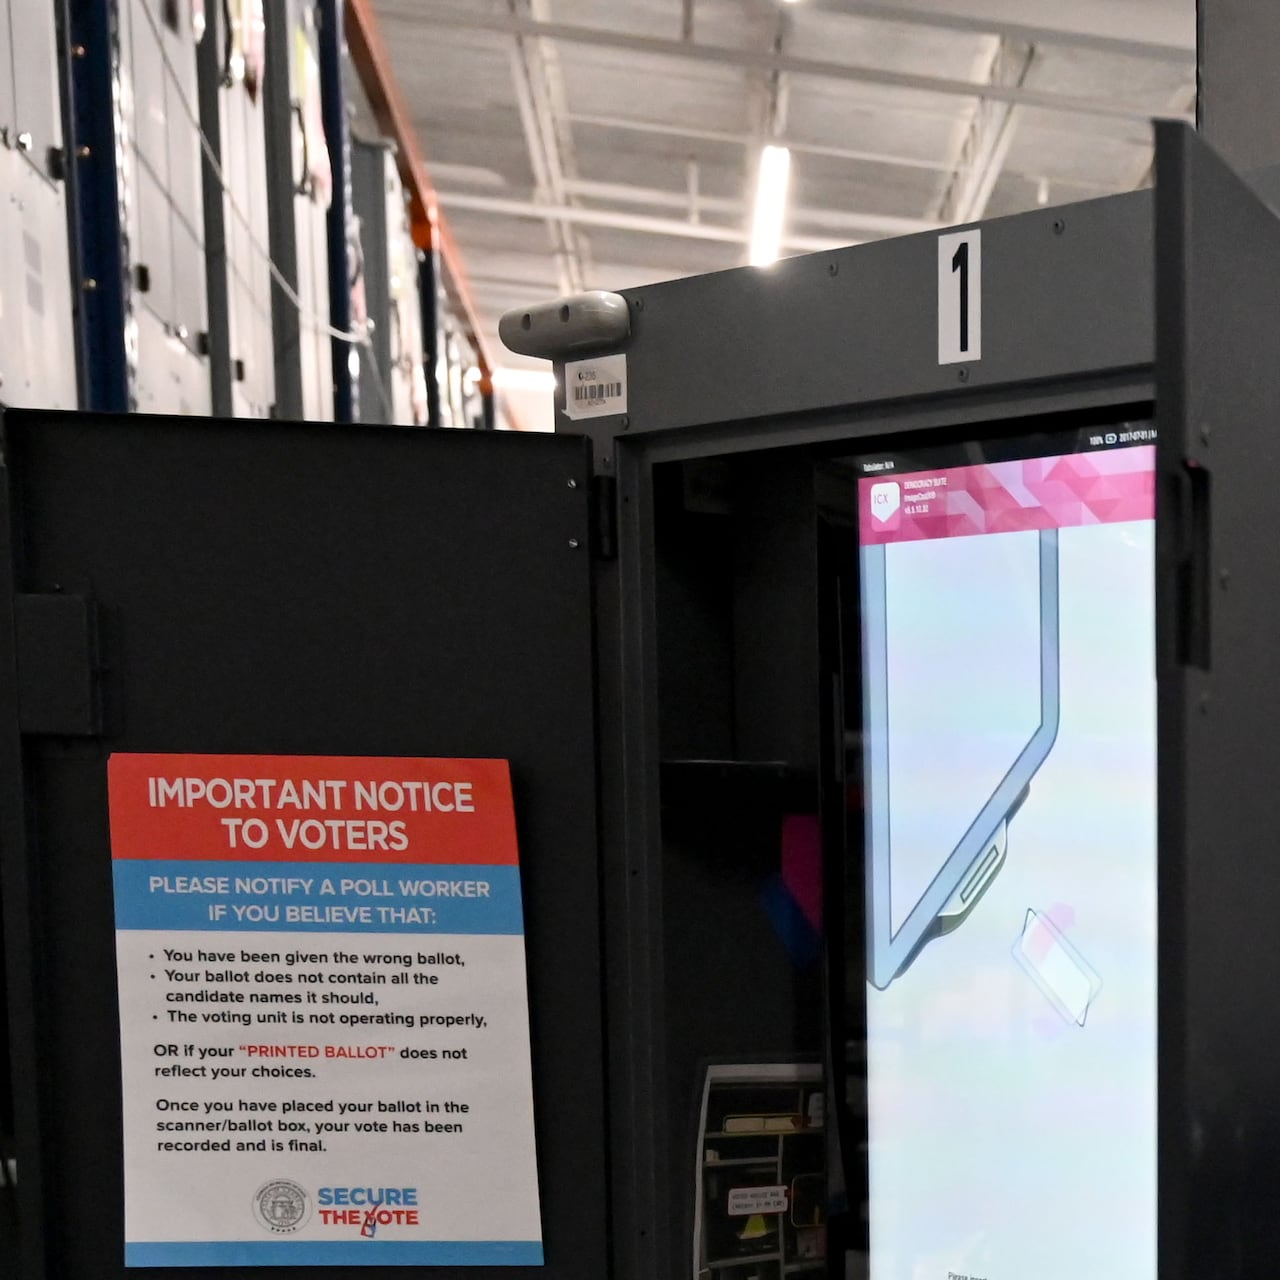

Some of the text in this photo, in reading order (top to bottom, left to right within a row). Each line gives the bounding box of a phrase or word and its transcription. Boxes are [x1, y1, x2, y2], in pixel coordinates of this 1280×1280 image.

[952, 242, 968, 352] 1
[874, 493, 889, 504] ICX
[148, 777, 476, 812] IMPORTANT NOTICE
[221, 818, 409, 851] TO VOTERS
[149, 876, 490, 898] PLEASE NOTIFY A POLL WORKER
[208, 904, 437, 925] IF YOU BELIEVE THAT:
[164, 949, 466, 968] You have been given the wrong ballot,
[165, 970, 439, 986] Your ballot does not contain all the
[166, 990, 380, 1007] candidate names it should,
[166, 1010, 488, 1030] The voting unit is not operating properly,
[154, 1044, 179, 1058] OR
[183, 1044, 195, 1058] if
[198, 1045, 234, 1060] your
[400, 1047, 438, 1060] does
[442, 1048, 468, 1061] not
[154, 1064, 316, 1082] reflect your choices.
[156, 1100, 470, 1117] Once you have placed your ballot in the
[156, 1118, 464, 1136] scanner/ballot box, your vote has been
[157, 1138, 328, 1153] recorded and is final.
[318, 1188, 418, 1207] SECURE
[319, 1210, 362, 1226] THE
